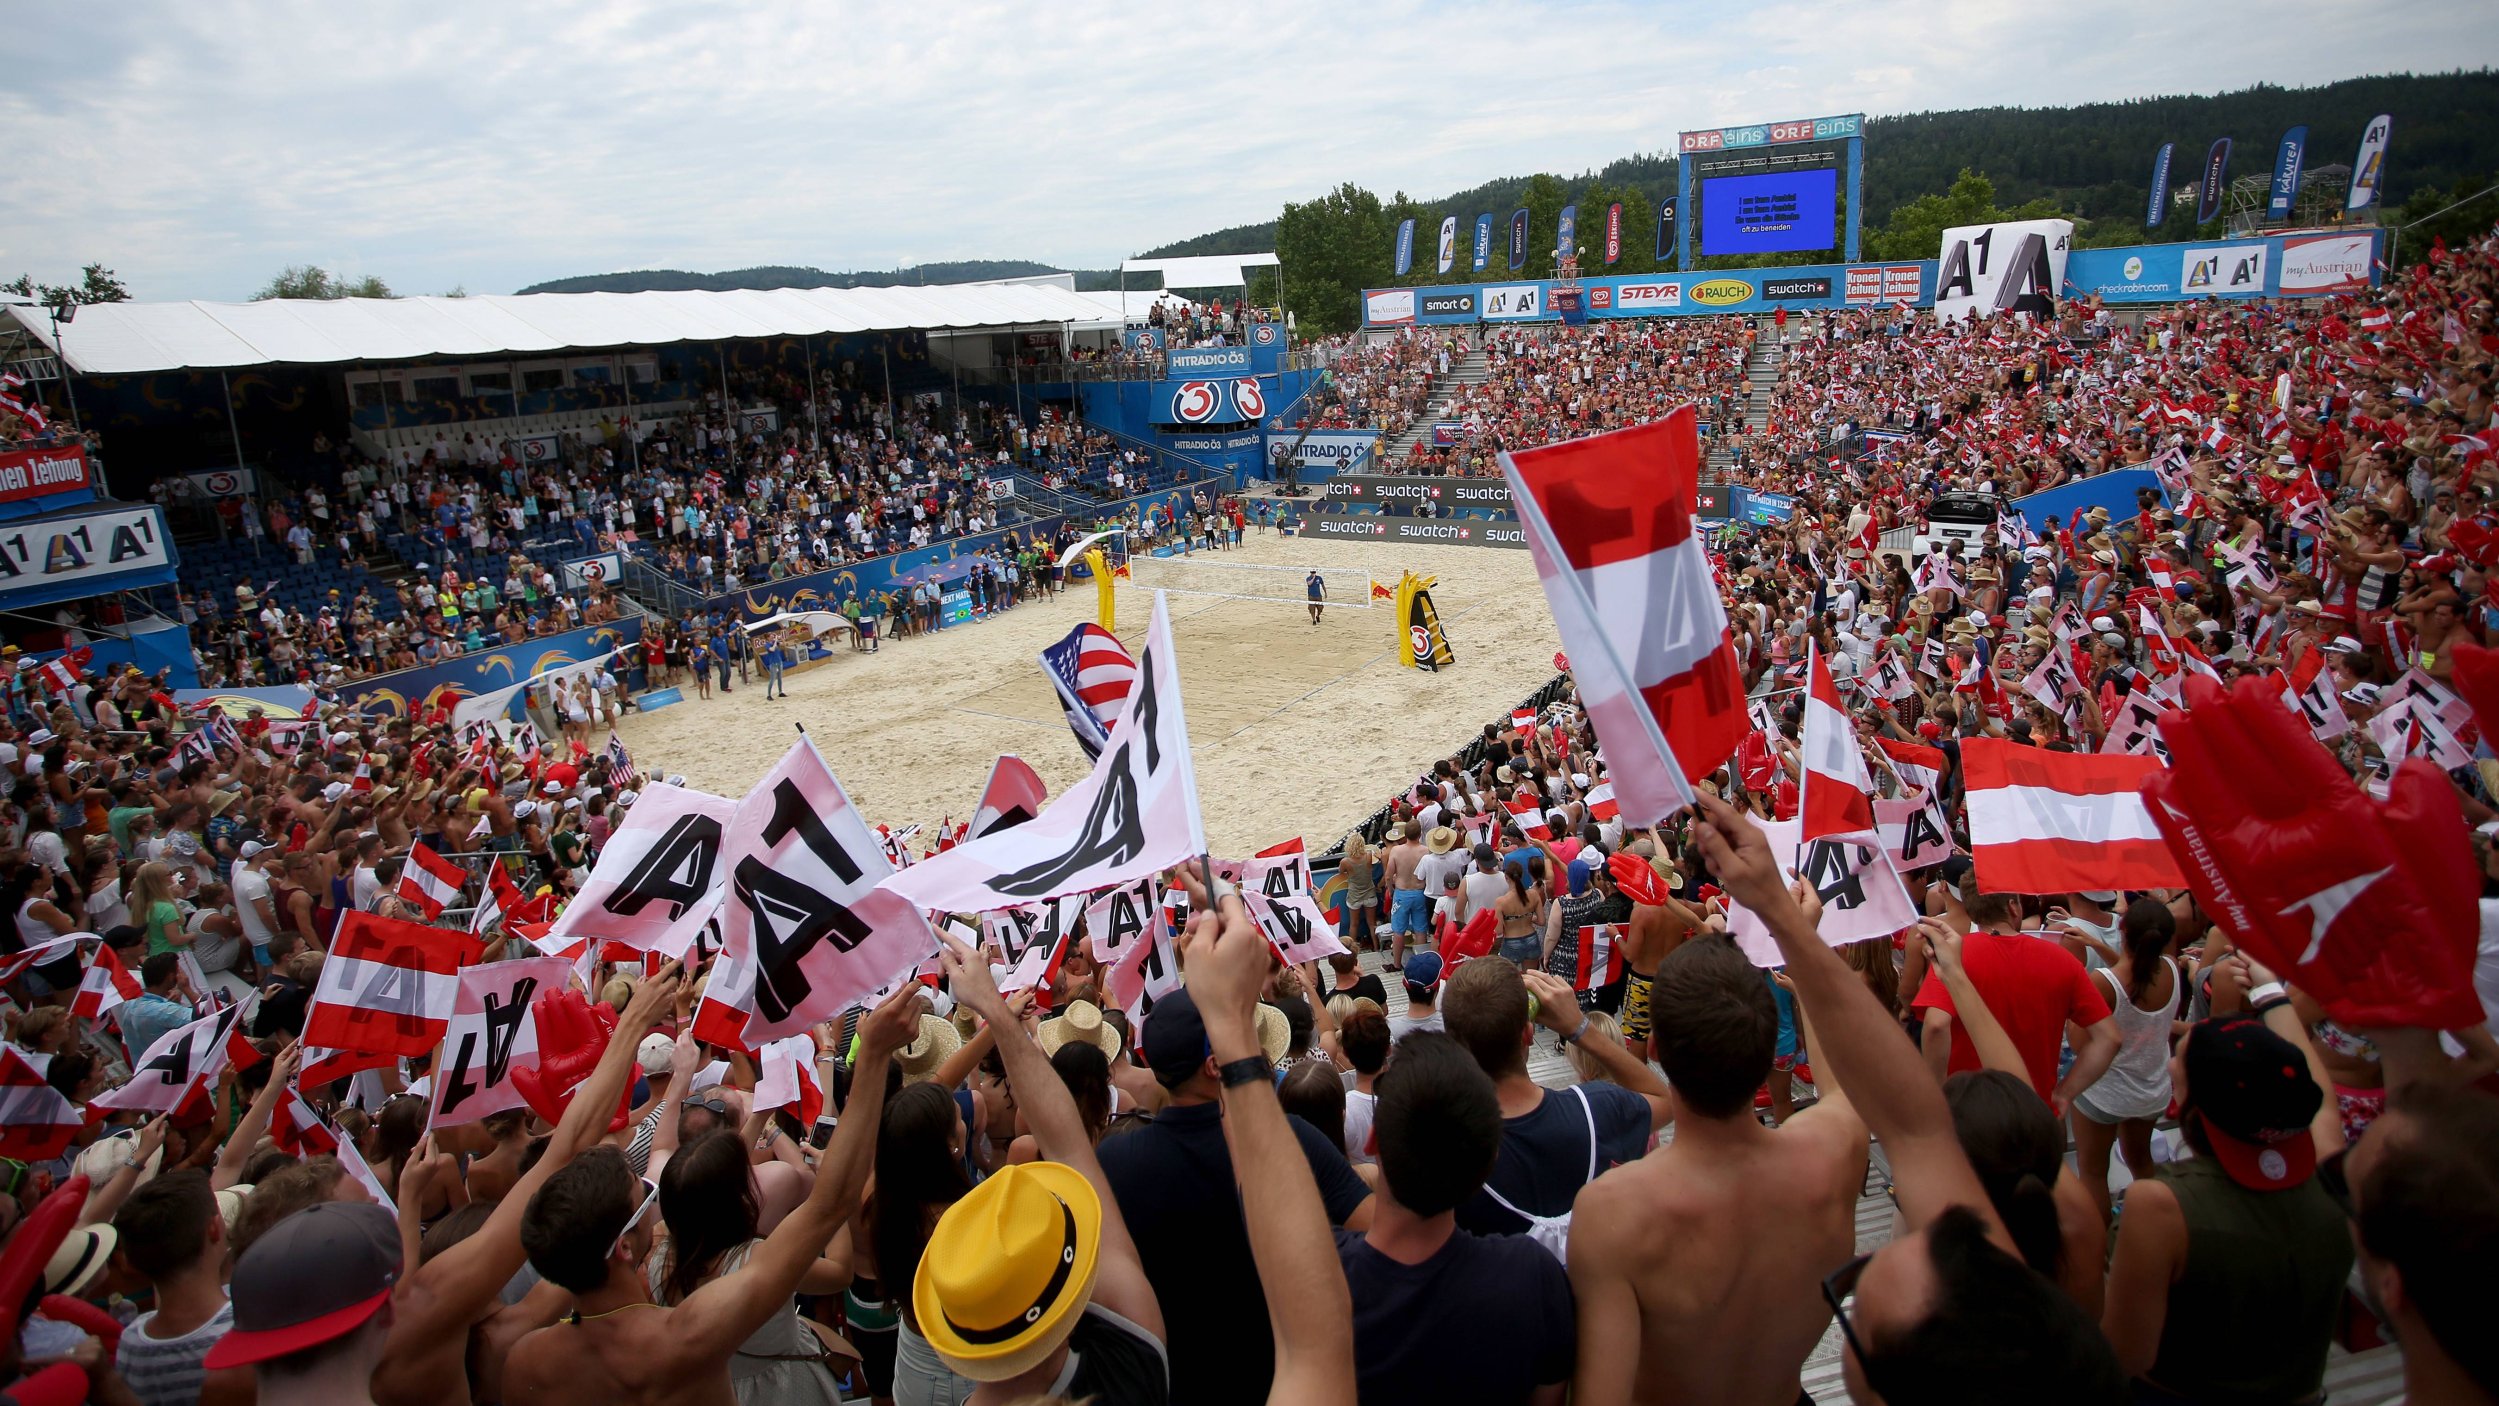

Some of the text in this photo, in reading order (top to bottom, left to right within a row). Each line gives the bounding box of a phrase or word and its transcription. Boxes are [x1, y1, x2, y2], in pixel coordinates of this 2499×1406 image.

[1684, 118, 1856, 149] ORF eins ORF eins
[2365, 125, 2386, 143] A1
[1610, 212, 1618, 240] ESKIMO
[1936, 228, 1993, 301] A1
[2187, 253, 2259, 287] A1 A1
[1847, 272, 1880, 283] Kronen
[1885, 271, 1919, 282] Kronen
[1620, 285, 1679, 300] STEYR
[1705, 286, 1745, 298] RAUCH
[1768, 283, 1816, 295] swatch
[1846, 283, 1880, 295] Zeitung
[1884, 282, 1919, 294] Zeitung
[2098, 283, 2168, 294] checkrobin.com
[1426, 299, 1458, 310] smart
[1487, 292, 1507, 313] A1
[1516, 291, 1534, 312] A1
[1172, 350, 1245, 367] HITRADIO Ö3
[1175, 438, 1222, 449] HITRADIO Ö3
[1227, 433, 1260, 448] HITRADIO Ö3
[28, 456, 84, 486] Zeitung
[1376, 484, 1431, 499] swatch
[1456, 486, 1515, 501] swatch
[1320, 521, 1526, 542] swatch swatch swat
[44, 525, 94, 574] A1
[109, 516, 154, 564] A1
[941, 593, 955, 605] NEXT
[984, 644, 1160, 897] A1
[2182, 825, 2251, 932] myAustrian
[734, 777, 873, 1025] A1
[1107, 878, 1152, 949] A1
[440, 977, 538, 1116] A1
